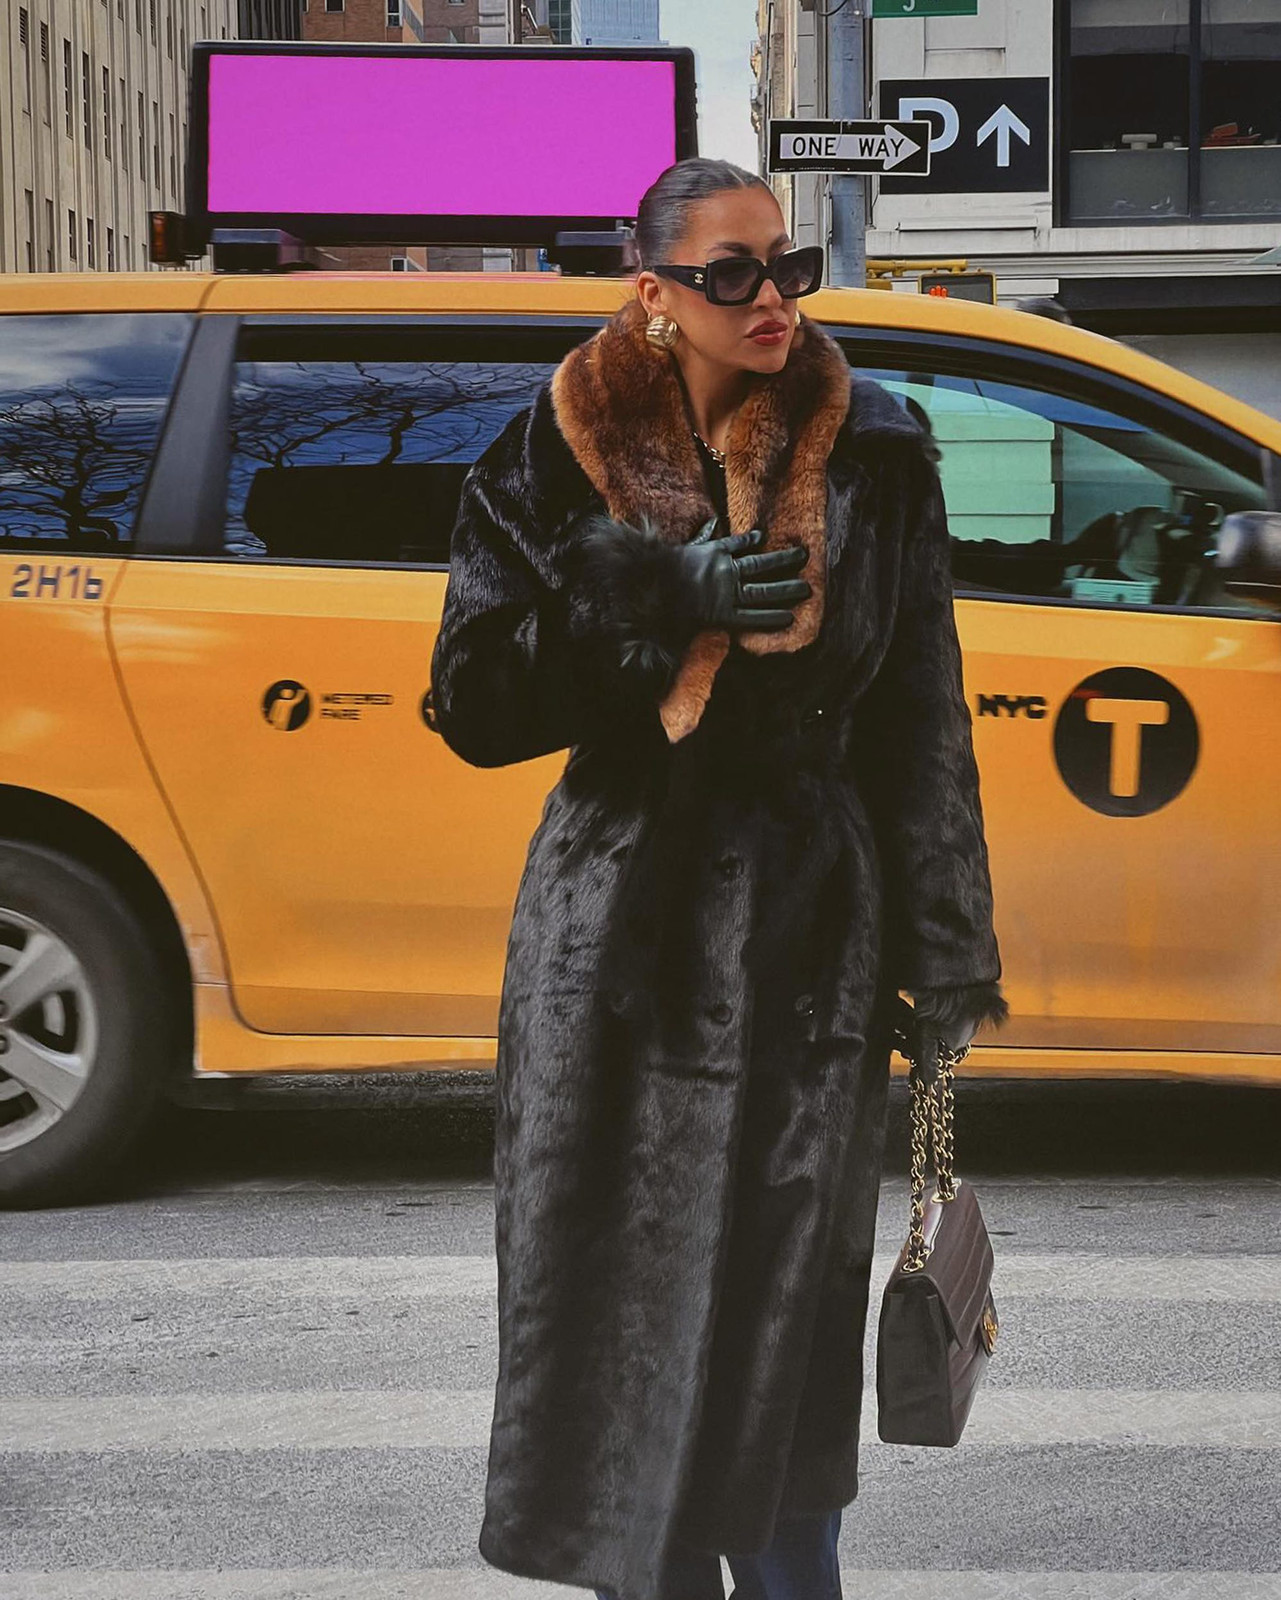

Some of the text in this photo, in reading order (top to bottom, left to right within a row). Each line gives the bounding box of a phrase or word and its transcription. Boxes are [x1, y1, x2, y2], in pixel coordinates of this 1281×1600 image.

[792, 136, 905, 158] ONE WAY
[975, 694, 1170, 797] NYC T
